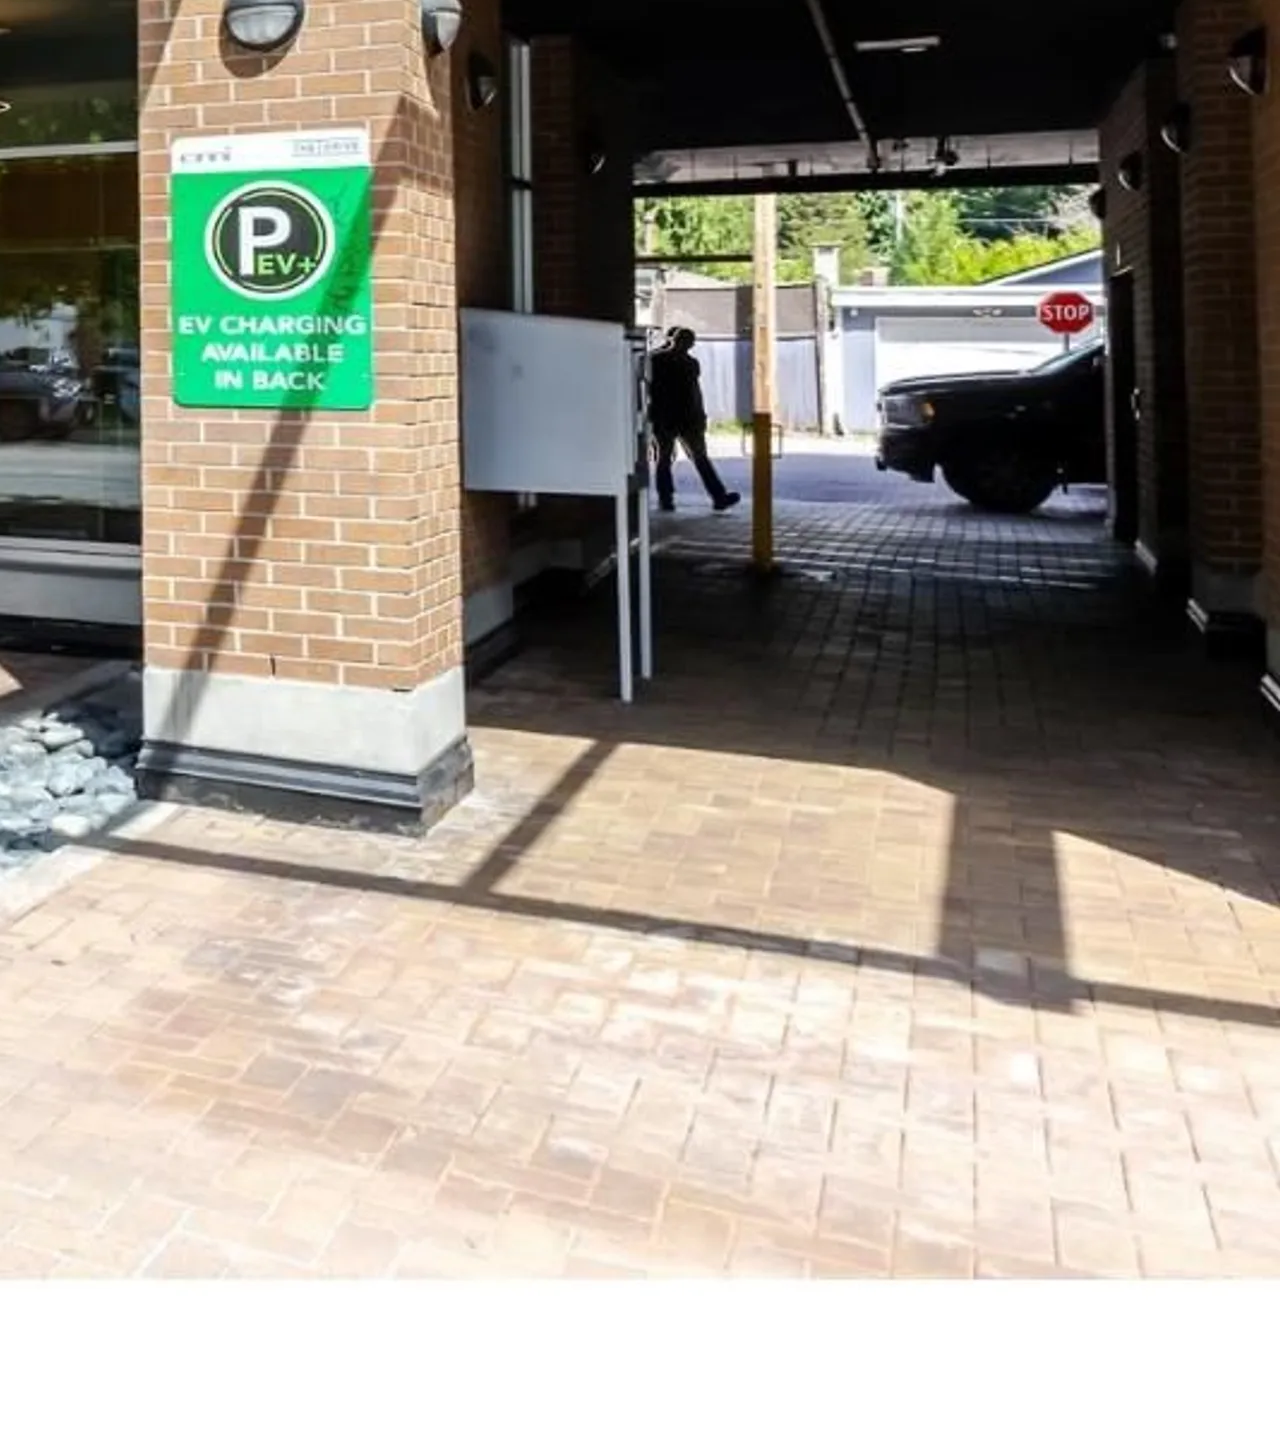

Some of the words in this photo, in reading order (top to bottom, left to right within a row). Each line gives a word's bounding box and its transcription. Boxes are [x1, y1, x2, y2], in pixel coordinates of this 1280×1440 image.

[239, 206, 290, 276] P
[1042, 304, 1089, 321] STOP
[179, 315, 211, 335] EV
[219, 314, 367, 335] CHARGING
[202, 343, 344, 362] AVAILABLE
[215, 370, 243, 390] IN
[252, 370, 326, 390] BACK
